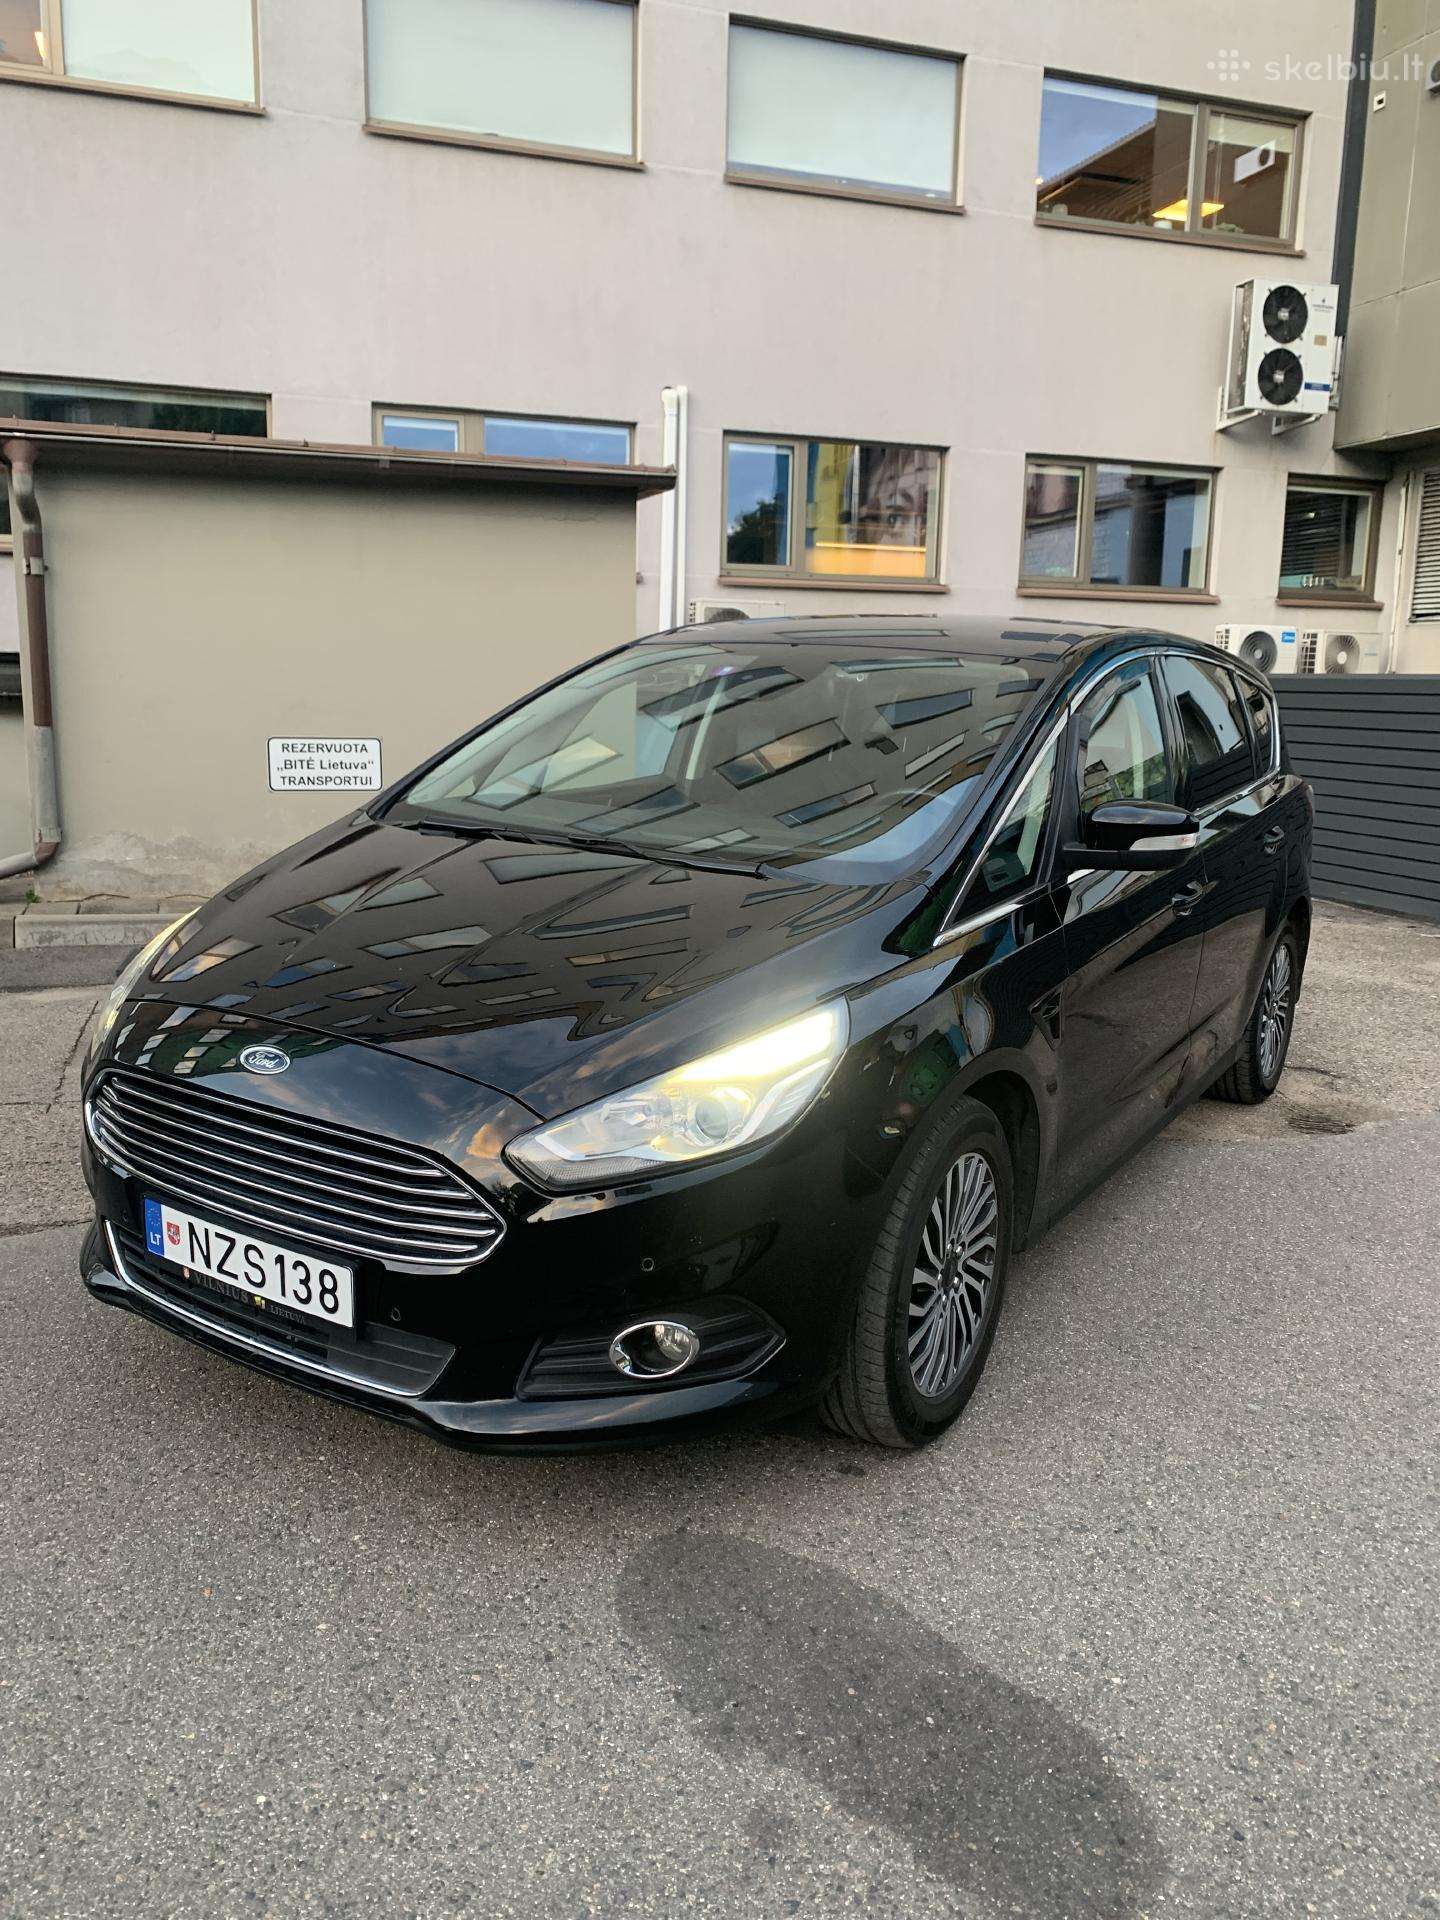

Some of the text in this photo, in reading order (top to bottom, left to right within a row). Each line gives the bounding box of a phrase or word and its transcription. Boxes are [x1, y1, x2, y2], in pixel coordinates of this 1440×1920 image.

[281, 743, 368, 753] REZERVUOTA
[280, 776, 372, 786] TRANSPORTUI
[249, 1051, 279, 1068] Ford
[150, 1232, 161, 1246] LT
[188, 1221, 339, 1314] NZS138
